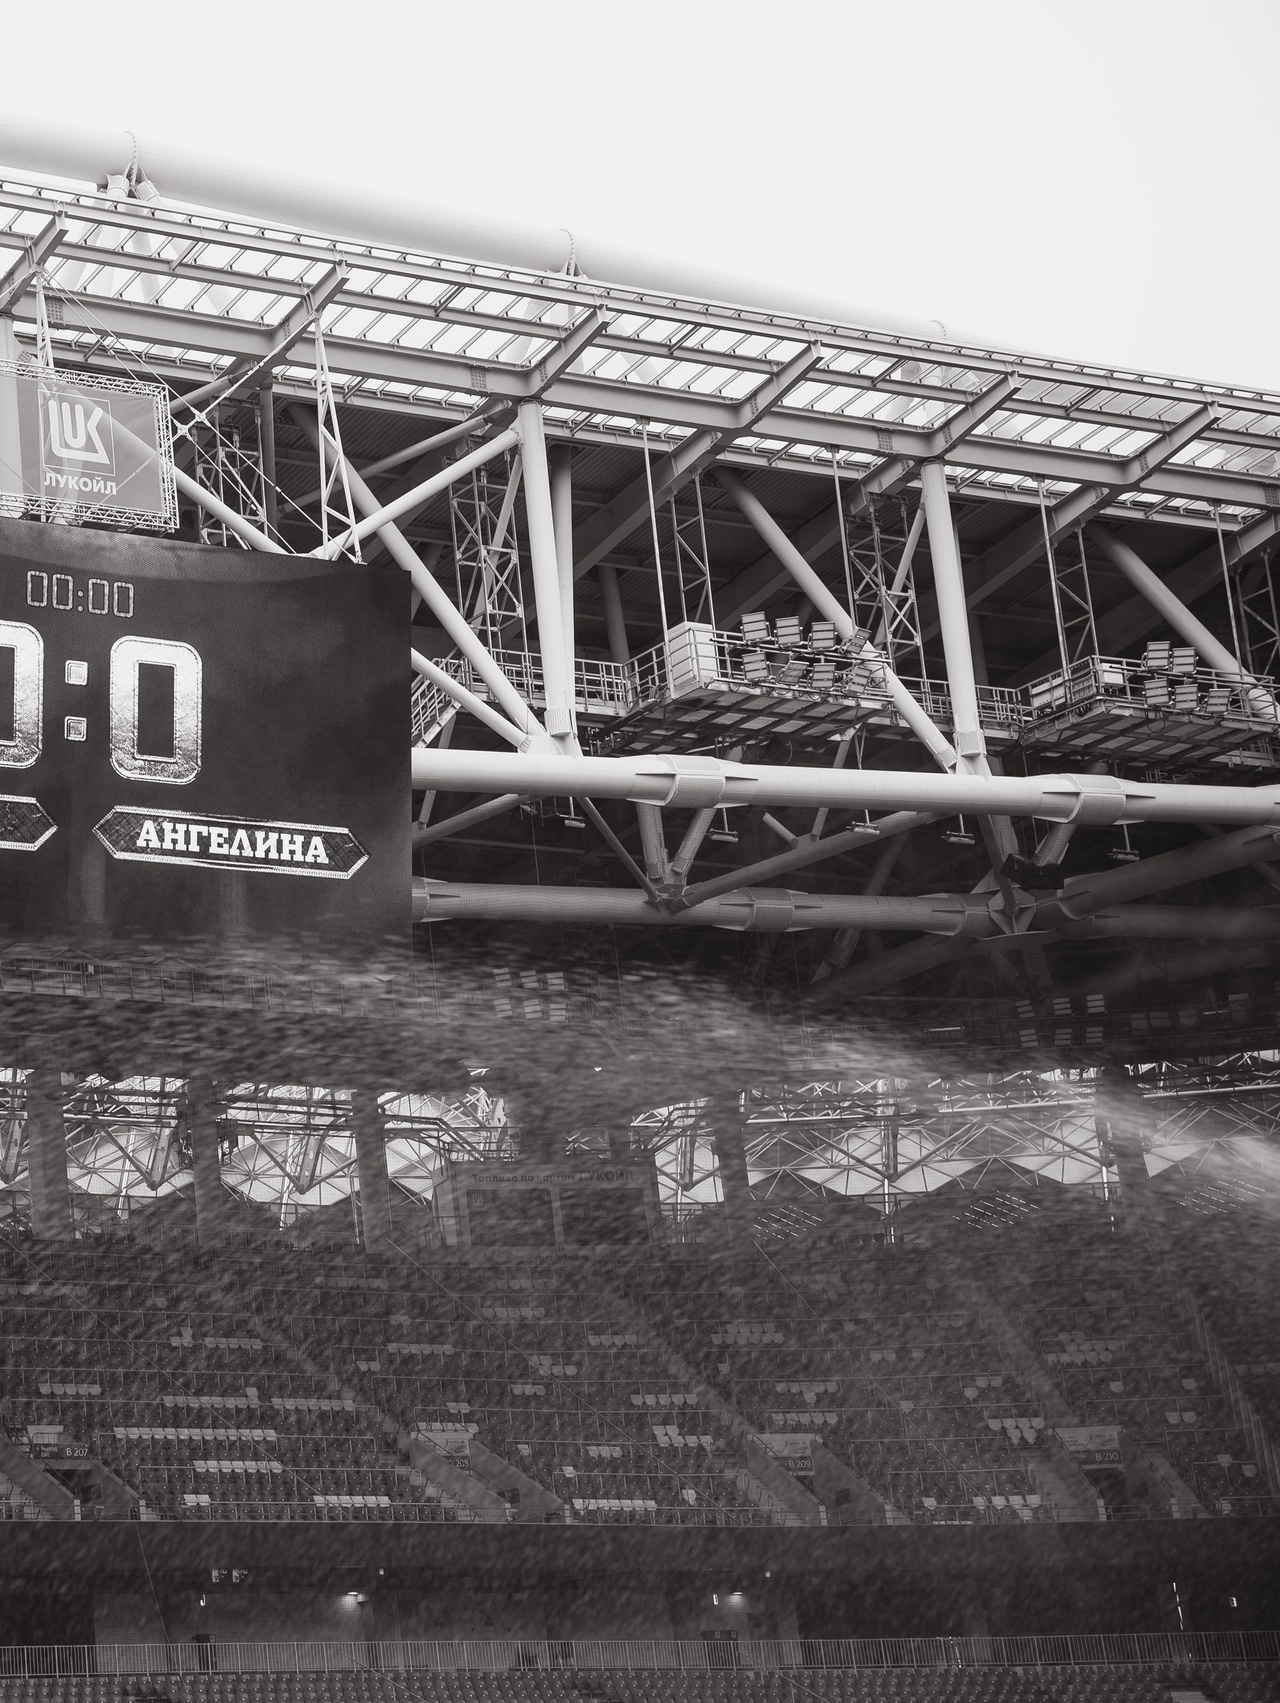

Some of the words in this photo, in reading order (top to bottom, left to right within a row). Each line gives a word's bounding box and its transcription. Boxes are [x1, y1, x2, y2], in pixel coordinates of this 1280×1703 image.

[44, 472, 117, 496] ЛУКОЙЛ
[26, 570, 135, 618] 00:00
[136, 819, 329, 864] АНГЕЛИНА
[471, 1173, 518, 1183] Топливо
[74, 1447, 89, 1457] 207
[1104, 1452, 1119, 1461] 210
[796, 1459, 812, 1468] 209
